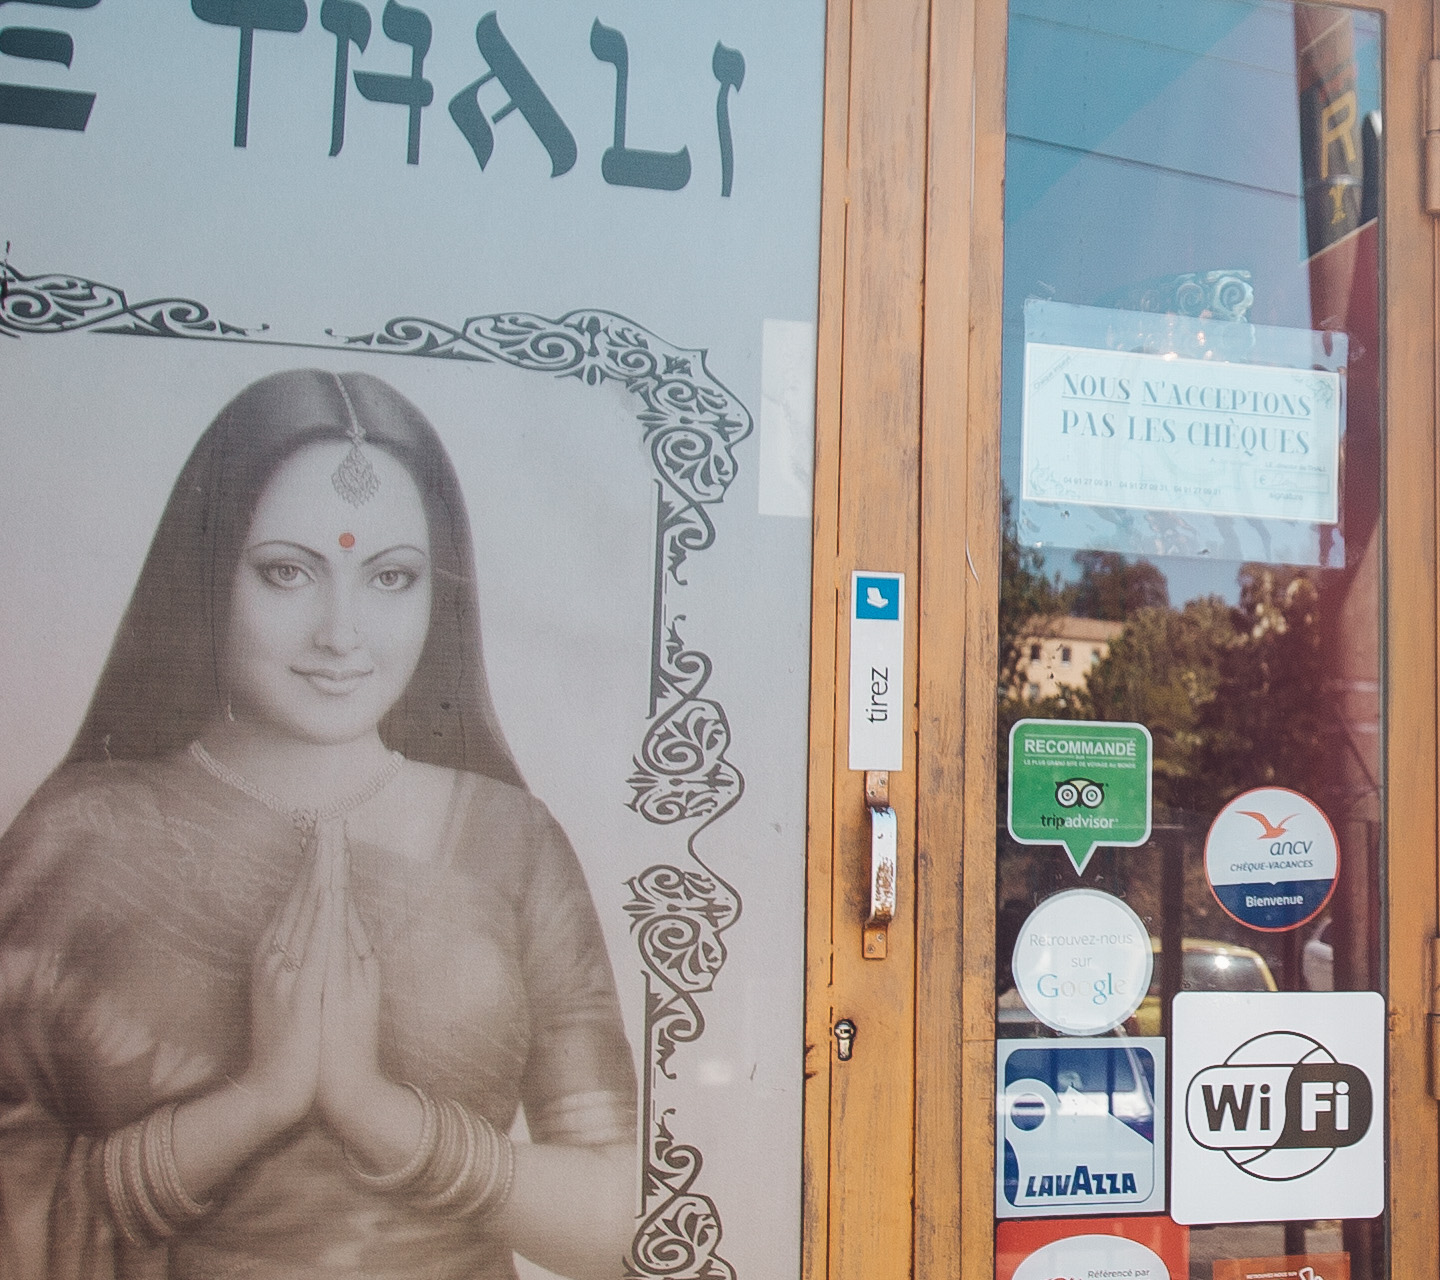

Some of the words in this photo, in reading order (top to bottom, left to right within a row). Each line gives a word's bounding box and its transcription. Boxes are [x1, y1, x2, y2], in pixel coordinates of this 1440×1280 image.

[1062, 372, 1131, 401] NOUS
[1142, 379, 1312, 417] N'ACCEPTONS
[1061, 408, 1116, 438] PAS
[1128, 414, 1176, 444] LES
[1187, 418, 1311, 457] CHÈQUES
[866, 666, 888, 723] tirez
[1024, 739, 1137, 757] RECOMMANDÉ
[1041, 813, 1115, 830] tripadvisor
[1270, 841, 1313, 856] ancv
[1230, 859, 1313, 873] CHÈQUE-VACANCES
[1245, 895, 1304, 908] Bienvenue
[1030, 933, 1133, 947] Retrouvez-nous
[1071, 957, 1092, 968] sur
[1037, 973, 1127, 1005] Google
[1025, 1165, 1137, 1198] LAVAZZA
[1135, 1270, 1150, 1279] par
